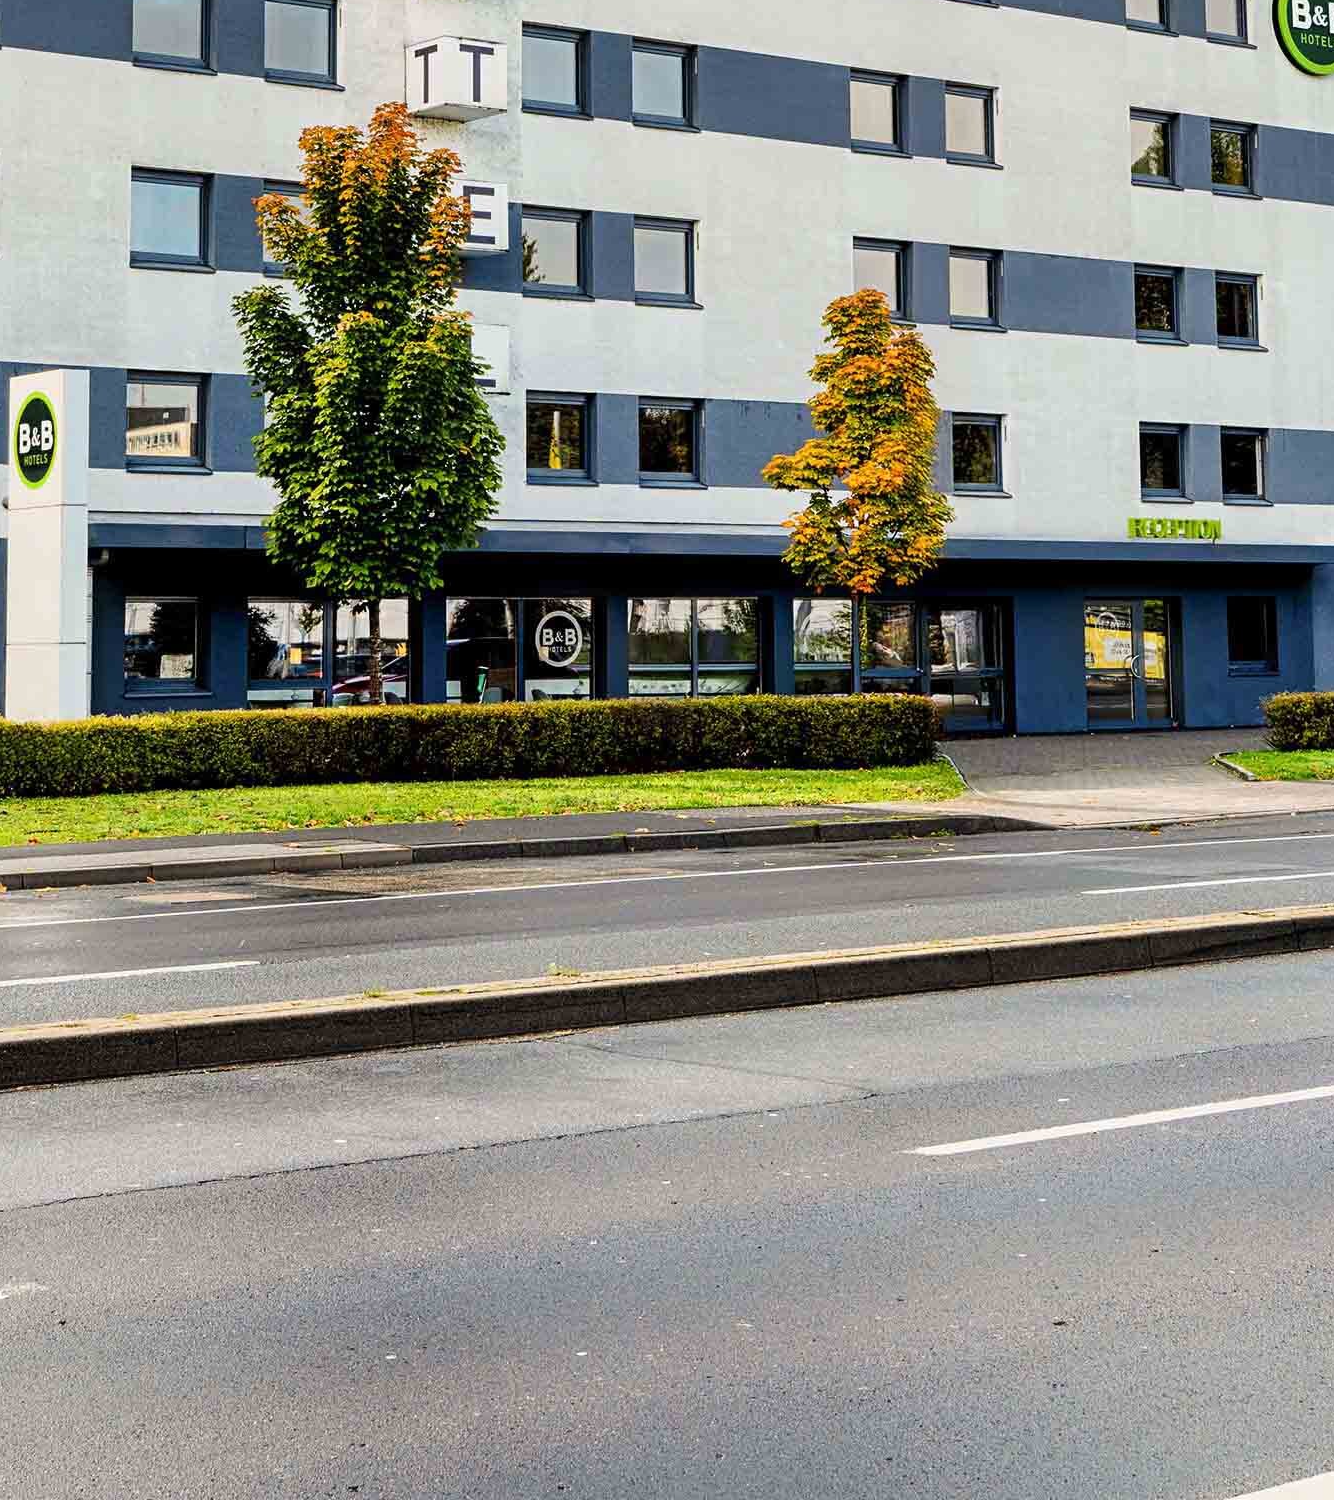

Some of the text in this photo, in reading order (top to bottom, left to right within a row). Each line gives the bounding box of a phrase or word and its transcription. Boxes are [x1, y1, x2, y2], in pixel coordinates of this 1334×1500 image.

[19, 420, 54, 454] B&B
[24, 453, 48, 467] HOTELS
[542, 628, 577, 646] B&B
